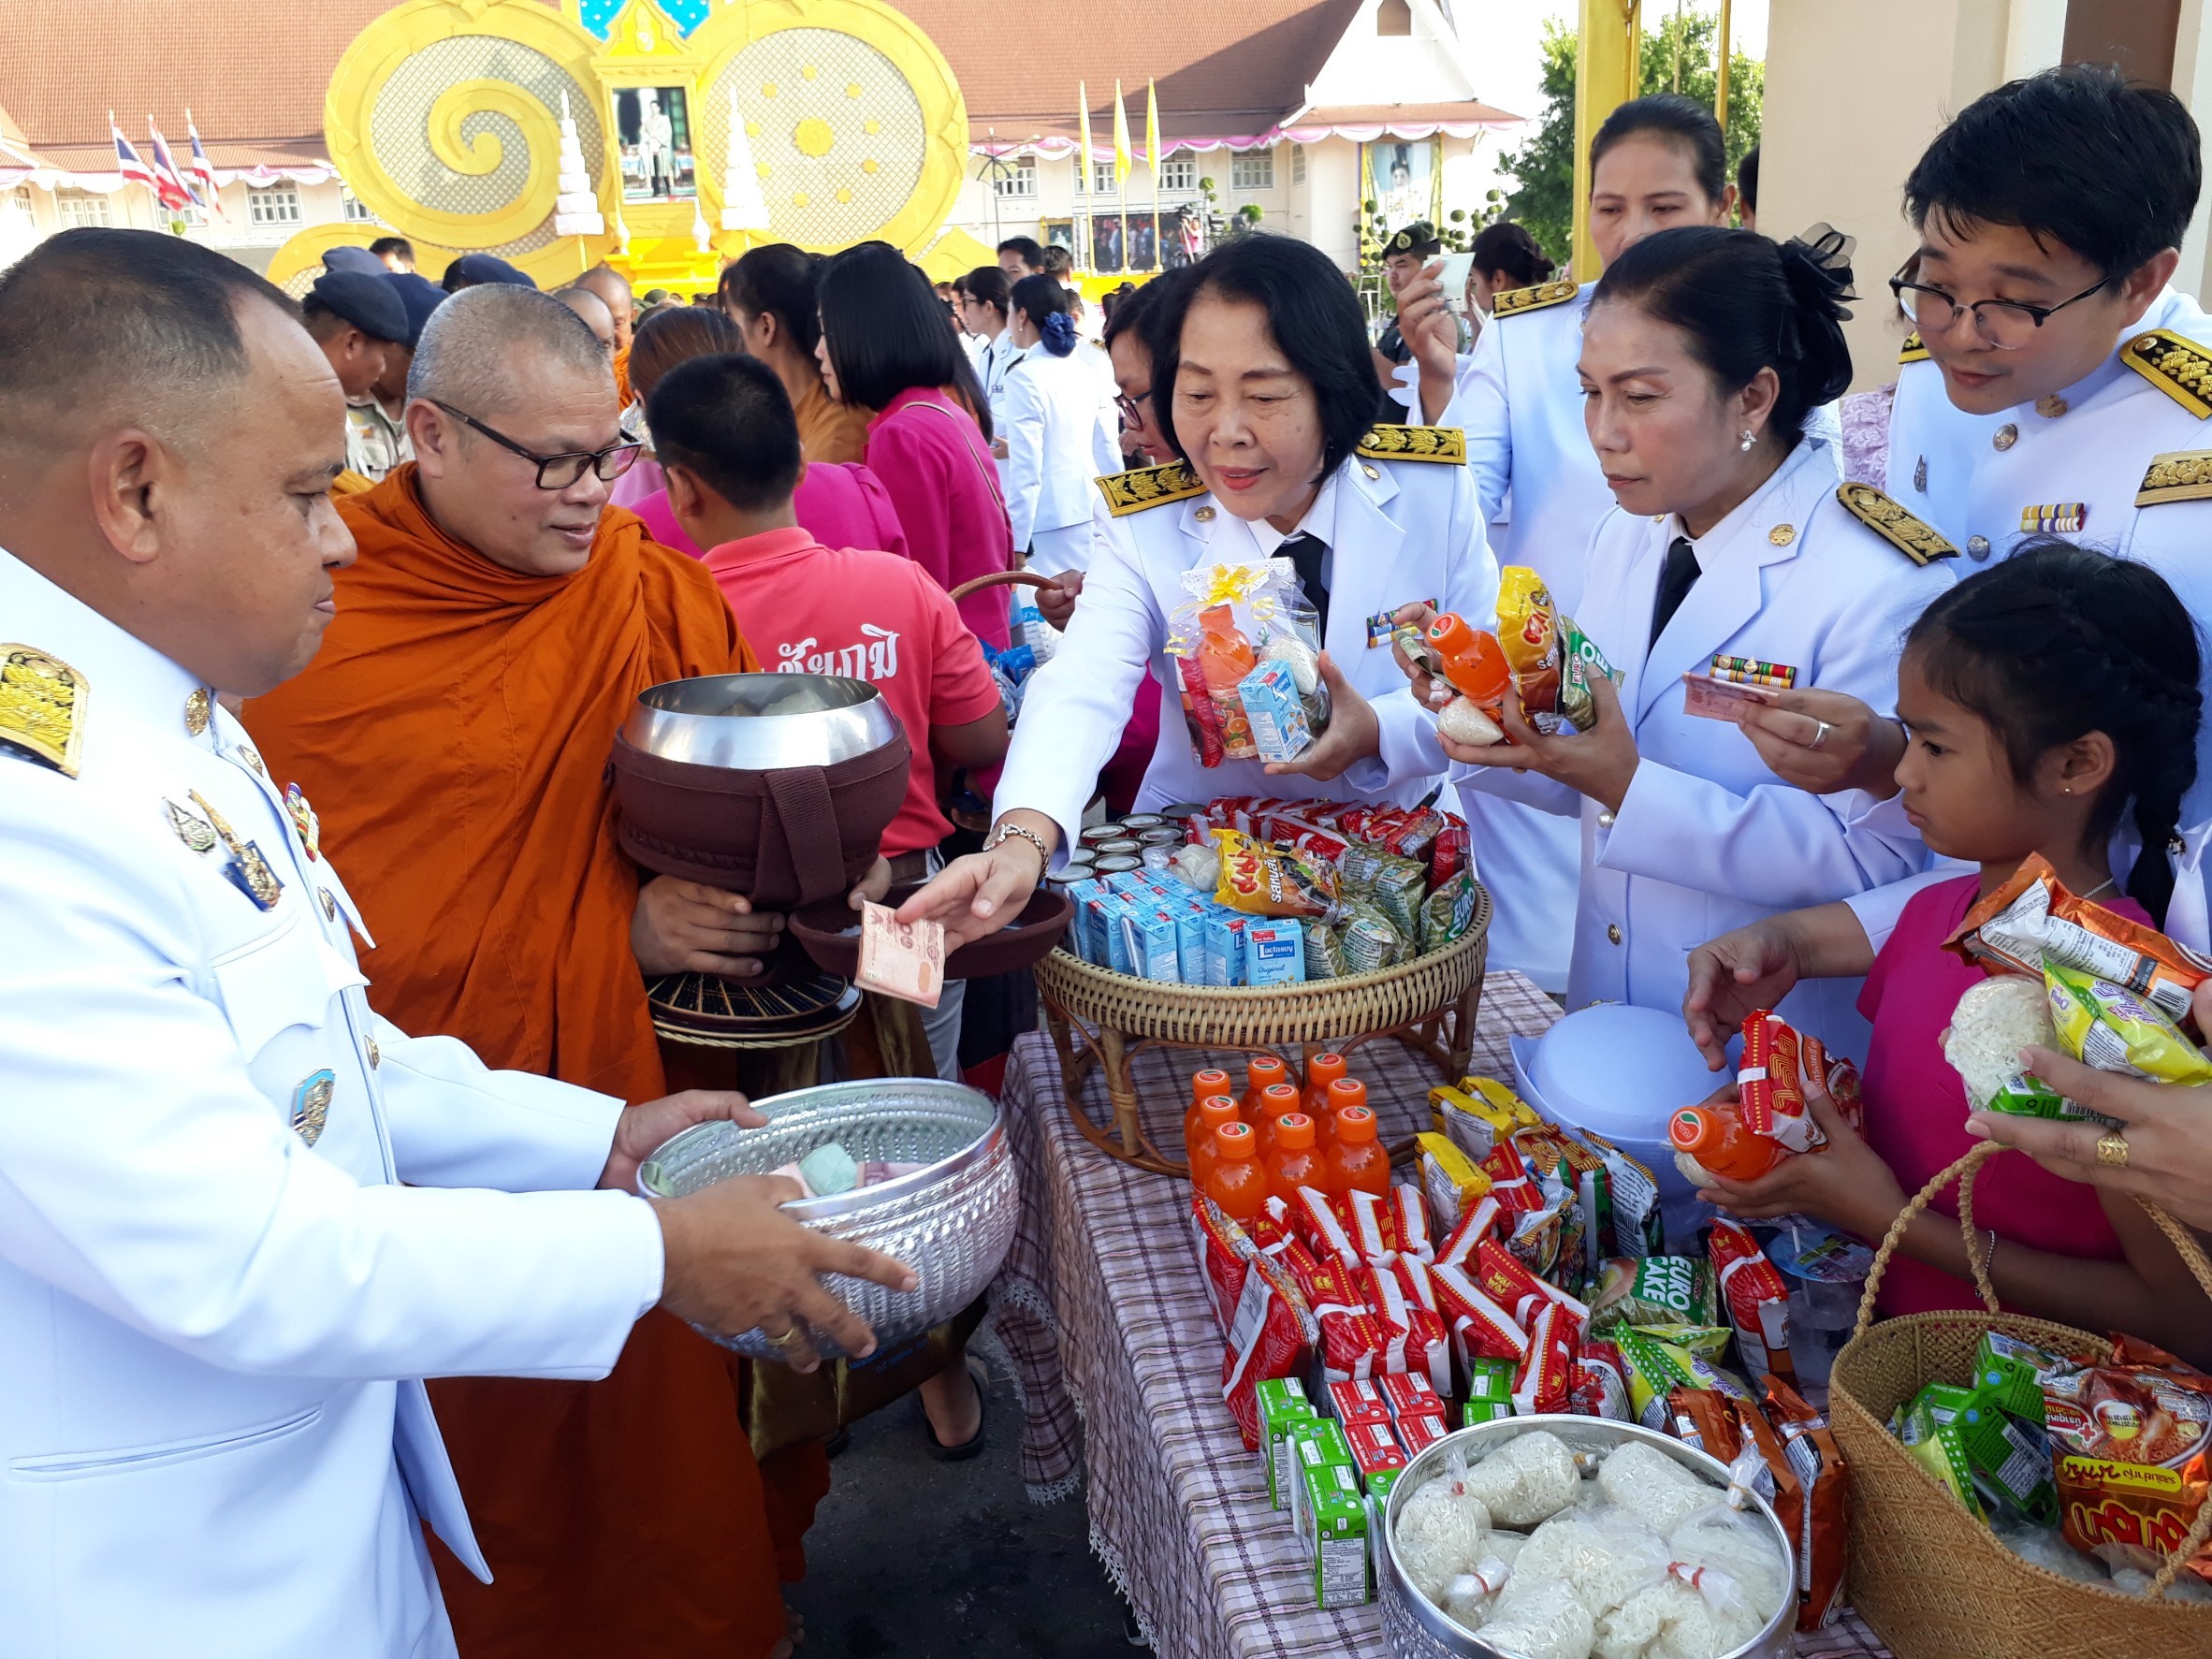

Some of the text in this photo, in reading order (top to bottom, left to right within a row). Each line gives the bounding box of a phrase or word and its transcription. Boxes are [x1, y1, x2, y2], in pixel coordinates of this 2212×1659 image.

[1259, 943, 1294, 959] Lactasoy
[1258, 964, 1286, 975] Original
[1488, 1276, 1506, 1294] WAI
[1493, 1272, 1511, 1288] WAI
[1642, 1256, 1668, 1303] CAKE
[1666, 1255, 1693, 1311] EURO
